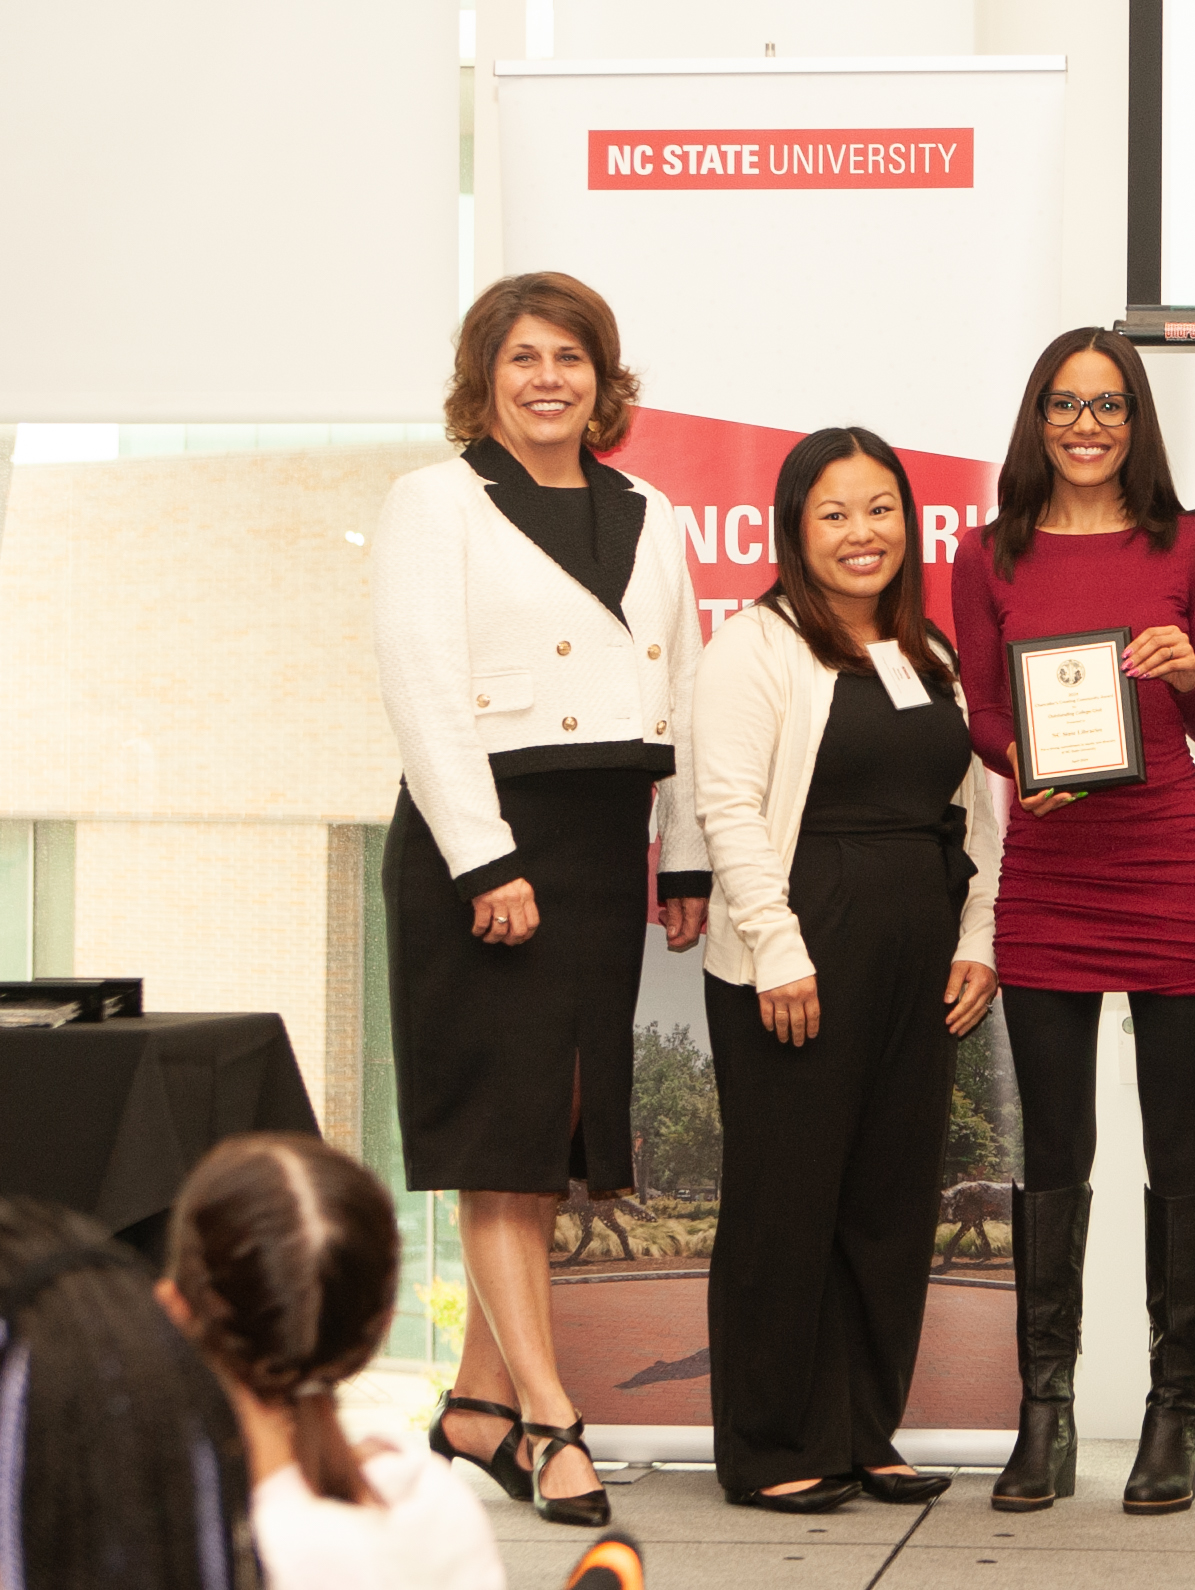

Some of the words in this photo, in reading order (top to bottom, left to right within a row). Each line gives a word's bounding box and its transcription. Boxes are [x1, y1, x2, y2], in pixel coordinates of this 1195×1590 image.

[607, 144, 654, 175] NC
[662, 144, 760, 175] STATE
[769, 142, 957, 175] UNIVERSITY
